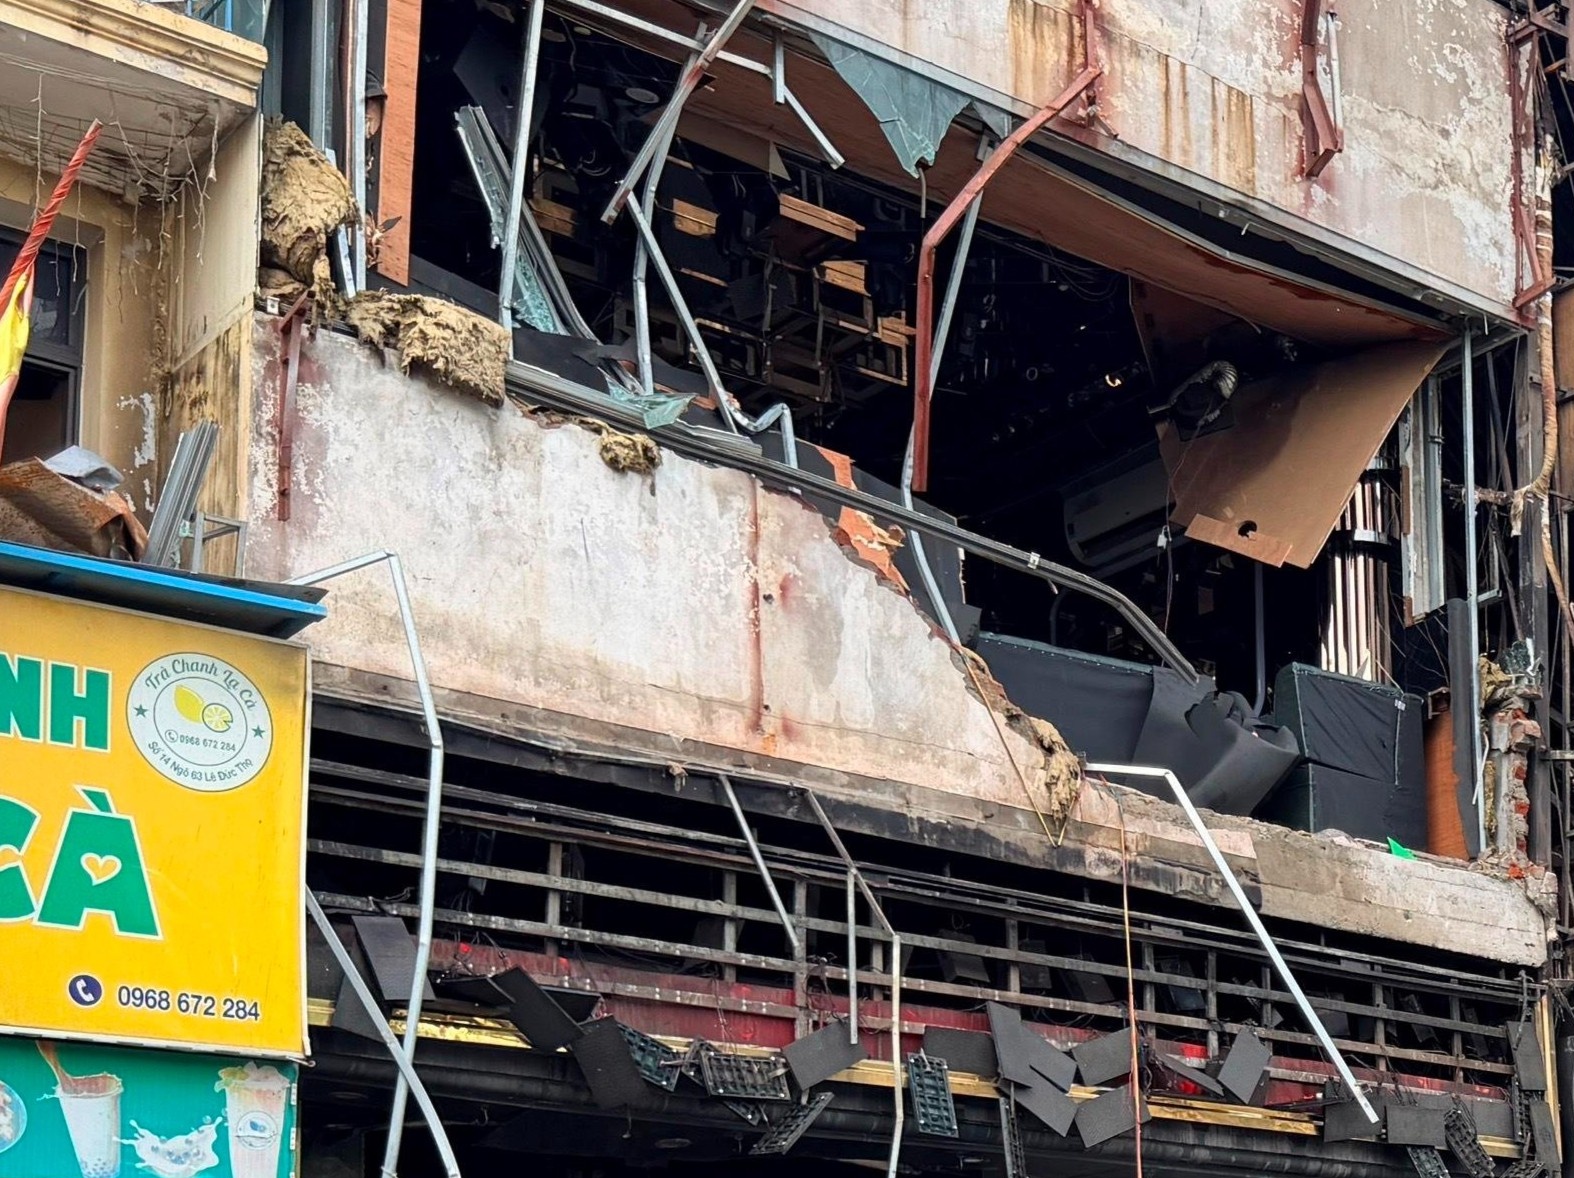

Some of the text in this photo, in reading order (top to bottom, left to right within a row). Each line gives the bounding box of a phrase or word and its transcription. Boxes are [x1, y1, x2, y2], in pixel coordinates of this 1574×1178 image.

[144, 665, 171, 690] Trà
[172, 658, 218, 677] Chanh
[240, 688, 258, 712] Cà
[148, 741, 164, 755] Số
[160, 753, 171, 765] 14
[190, 770, 203, 781] 63
[179, 733, 236, 752] 0968 672 284
[118, 985, 260, 1021] 0968 672 284
